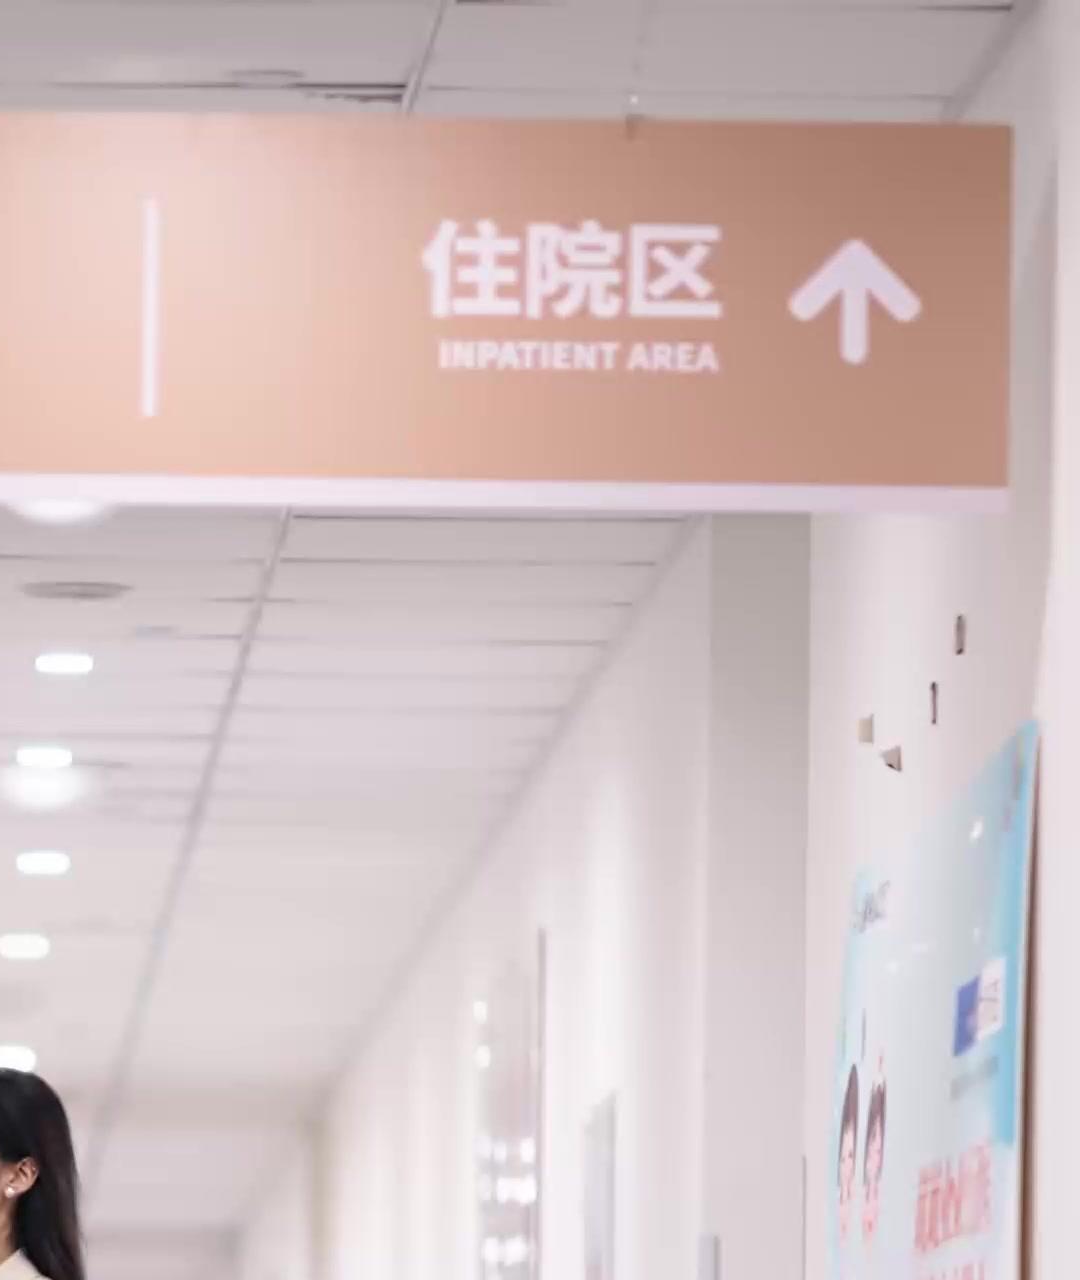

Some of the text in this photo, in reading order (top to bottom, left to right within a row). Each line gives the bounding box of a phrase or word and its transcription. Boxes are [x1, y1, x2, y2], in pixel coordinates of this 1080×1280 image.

[421, 218, 722, 319] 住院区
[438, 338, 721, 374] INPATIENT AREA
